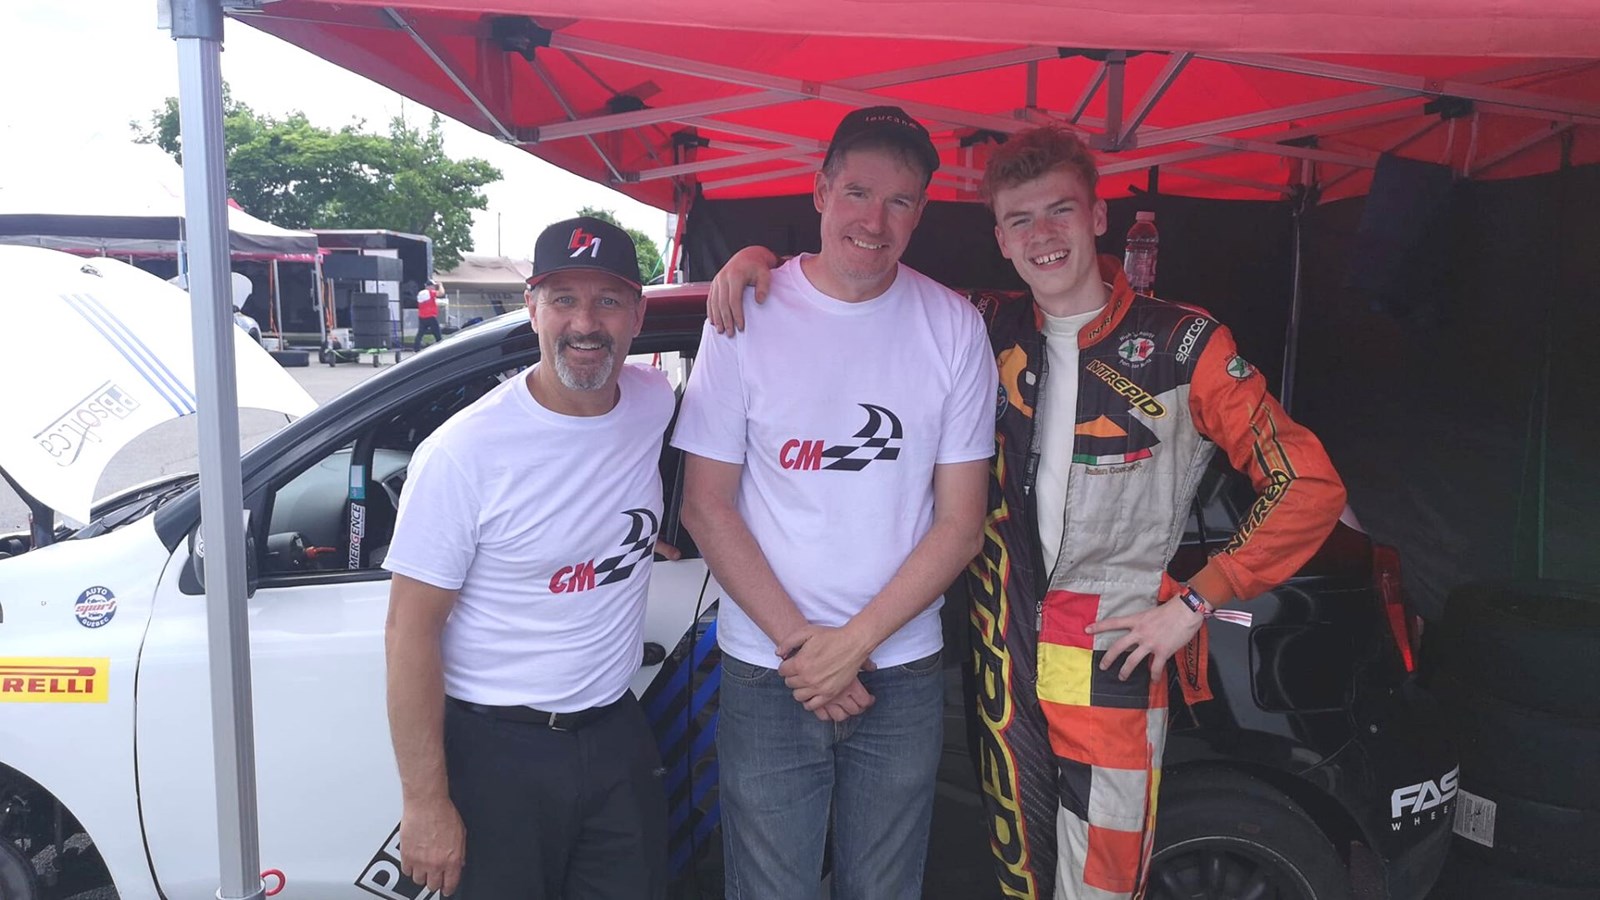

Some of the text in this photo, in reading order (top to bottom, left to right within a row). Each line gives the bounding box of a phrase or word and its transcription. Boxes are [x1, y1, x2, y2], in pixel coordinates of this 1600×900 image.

[1175, 317, 1206, 364] sparco
[1086, 359, 1167, 419] INTREPID
[779, 438, 825, 470] CM
[85, 587, 108, 597] AUTO
[548, 557, 596, 594] CM
[2, 677, 94, 693] RELLI
[1391, 764, 1459, 818] FAS
[1391, 801, 1456, 831] WHEE
